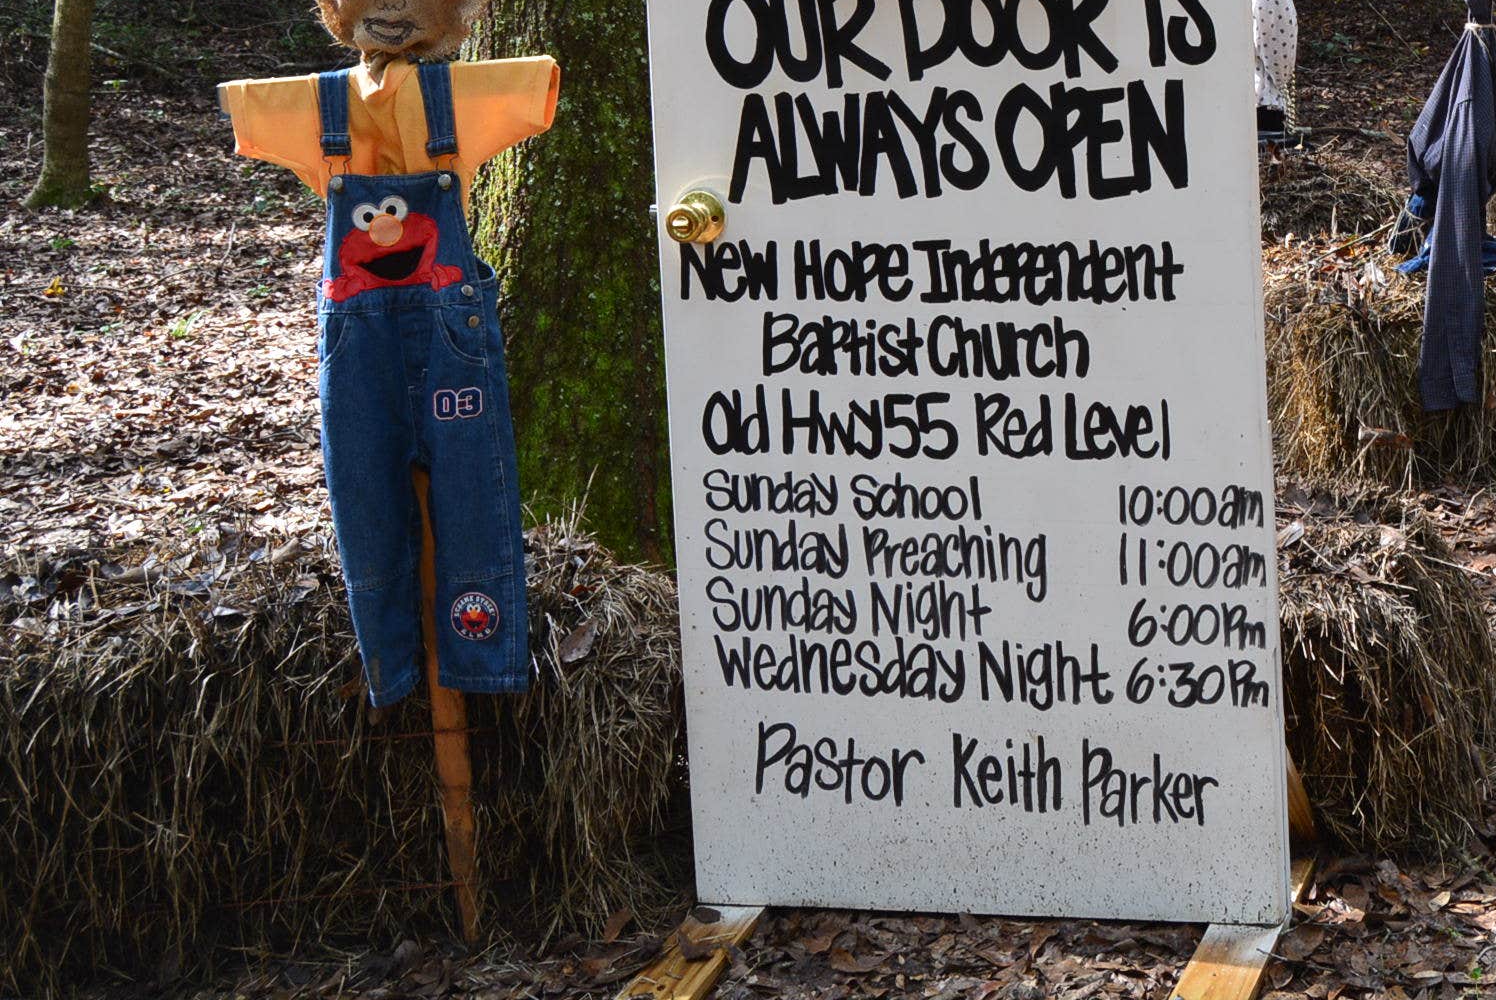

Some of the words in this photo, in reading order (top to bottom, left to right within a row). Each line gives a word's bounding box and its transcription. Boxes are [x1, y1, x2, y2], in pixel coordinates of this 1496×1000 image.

[728, 86, 990, 204] ALWAYS
[995, 79, 1189, 200] OPEN
[680, 239, 778, 302] New
[927, 314, 1090, 380] Church
[433, 387, 482, 420] 03
[702, 384, 769, 455] Old
[974, 392, 1053, 459] Red
[1065, 393, 1171, 461] Level
[703, 469, 838, 518] Sunday
[850, 472, 982, 521] School
[704, 518, 849, 580] Sunday
[862, 524, 1047, 602] Preaching
[705, 575, 858, 635] Sunday
[869, 581, 993, 642] Night
[714, 634, 966, 704] Wednesday
[978, 640, 1114, 712] Night
[755, 722, 926, 807] Pastor
[952, 733, 1062, 813] Keith
[1082, 738, 1219, 828] Parker
